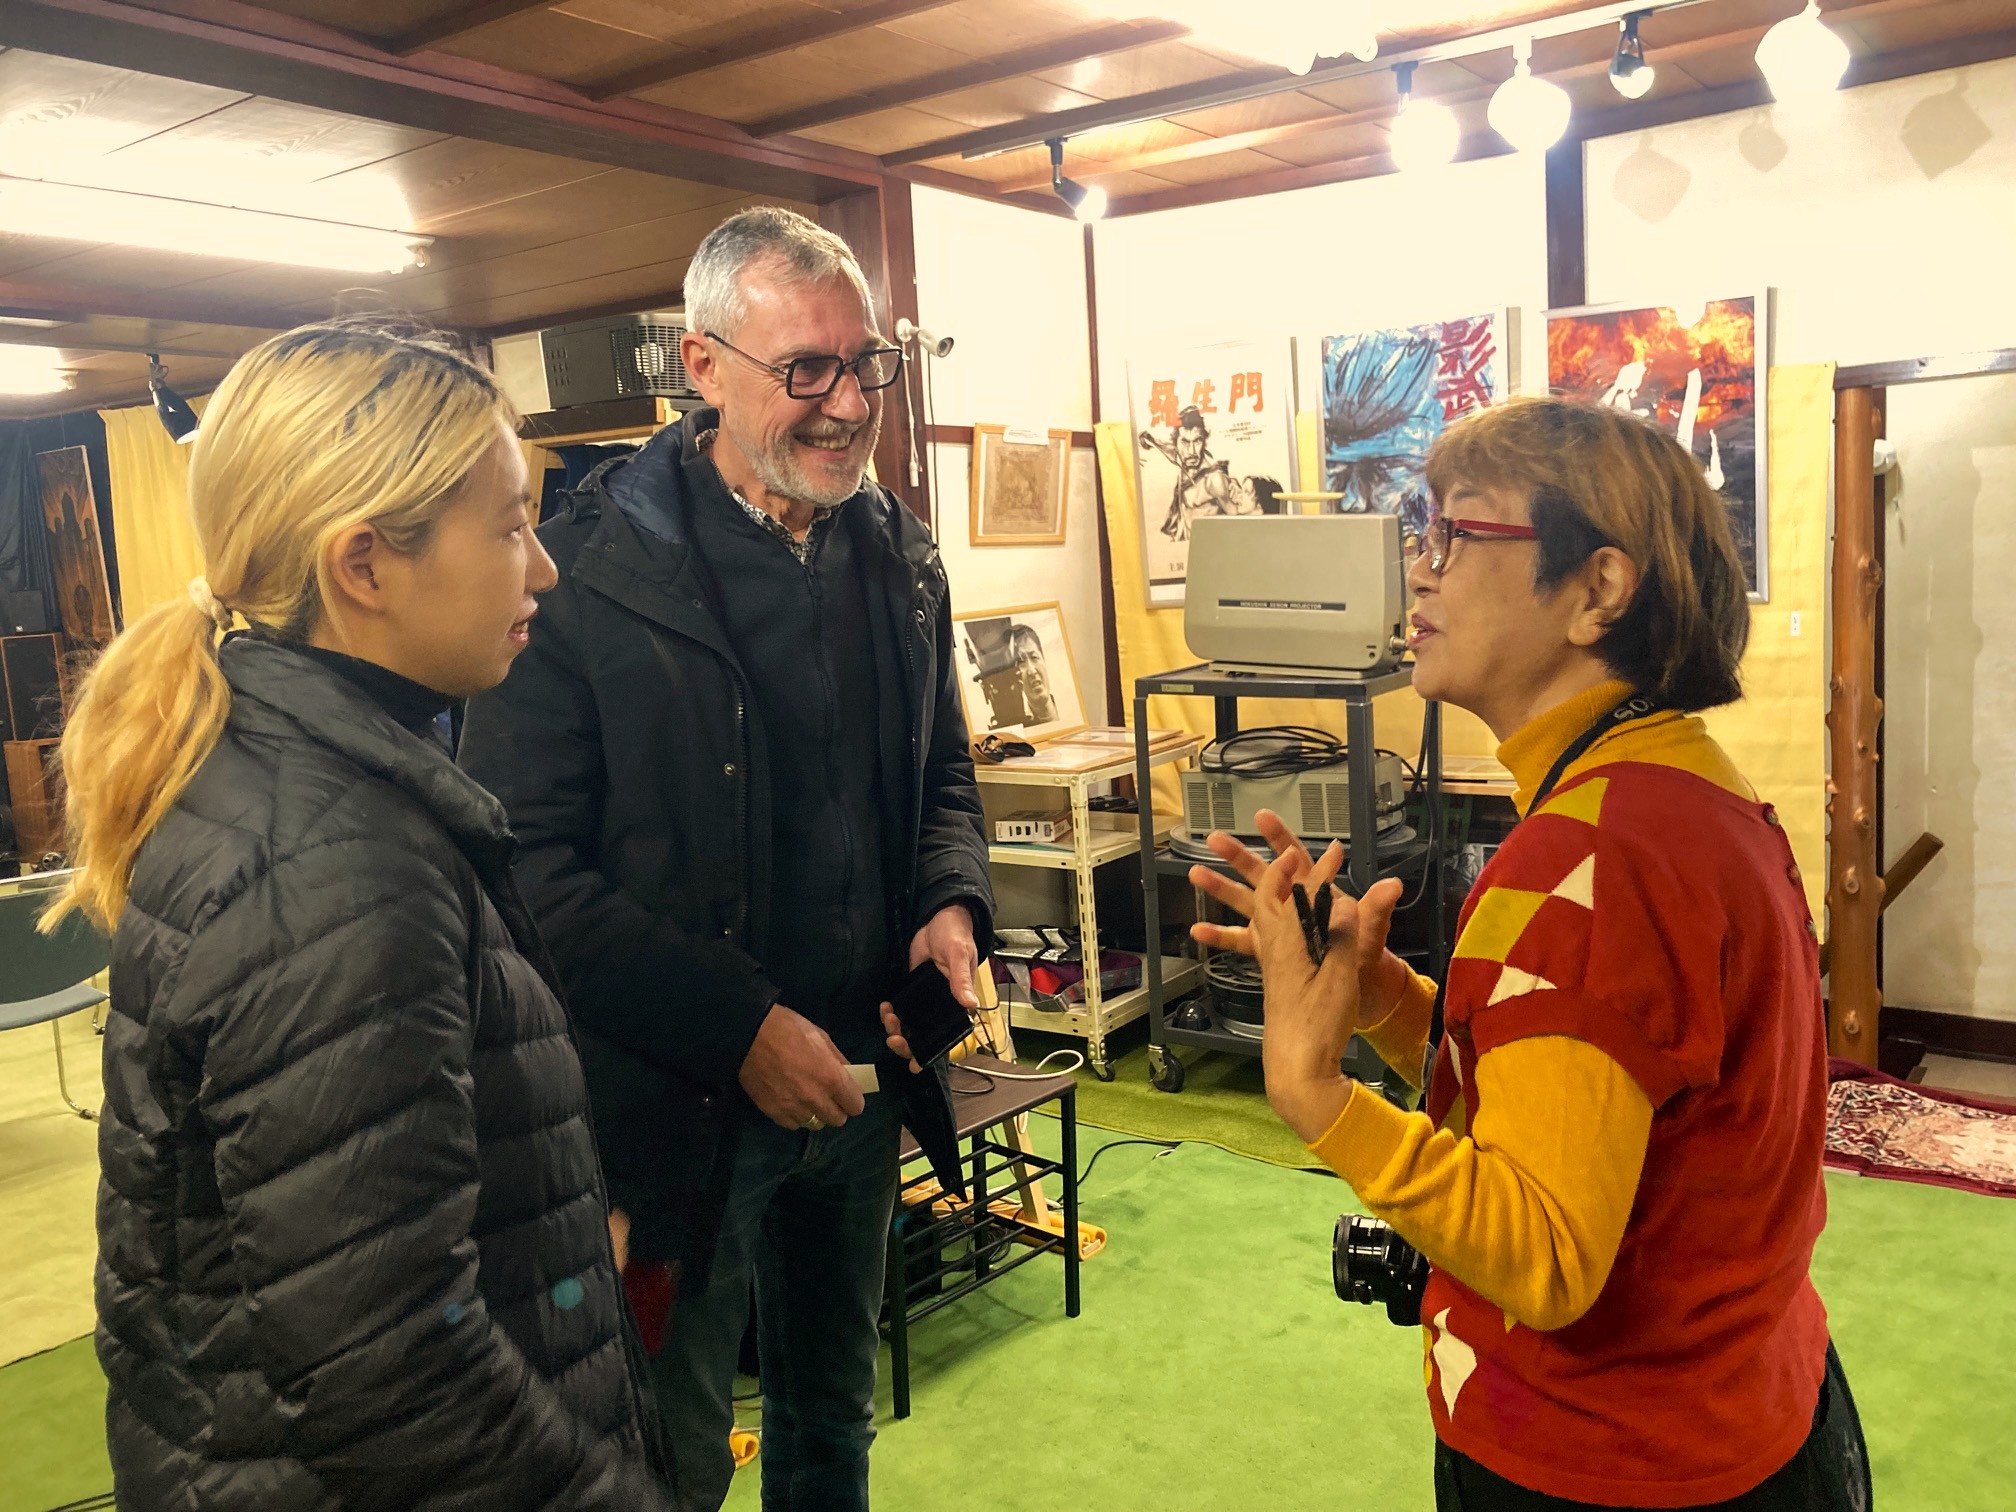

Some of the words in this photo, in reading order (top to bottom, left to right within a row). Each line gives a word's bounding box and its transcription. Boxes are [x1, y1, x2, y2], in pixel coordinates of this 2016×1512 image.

[1148, 372, 1264, 428] 羅生門
[1614, 699, 1655, 719] SO
